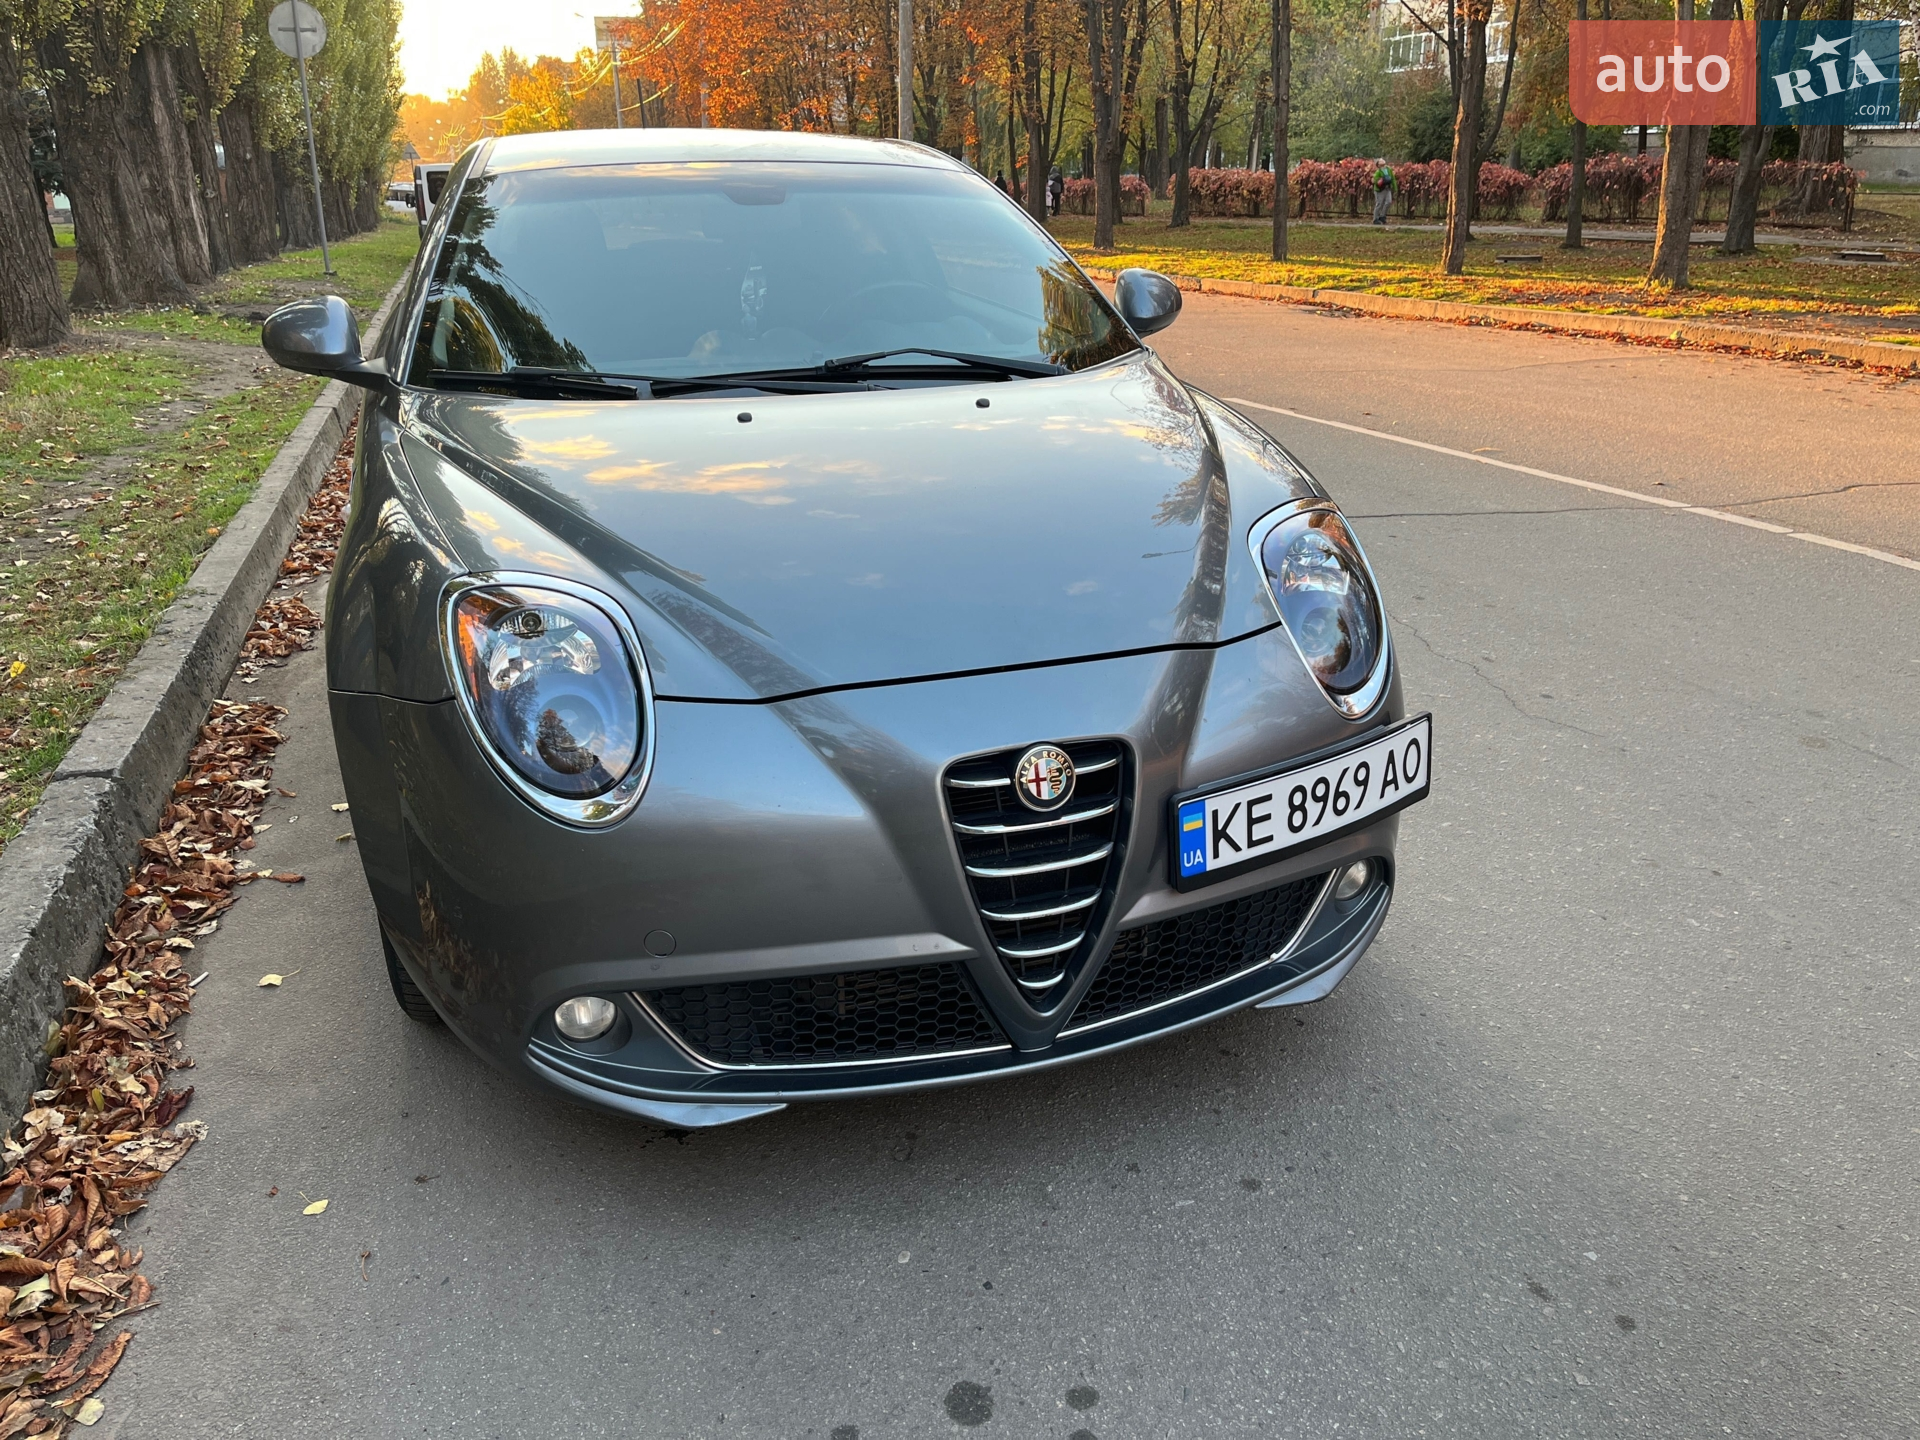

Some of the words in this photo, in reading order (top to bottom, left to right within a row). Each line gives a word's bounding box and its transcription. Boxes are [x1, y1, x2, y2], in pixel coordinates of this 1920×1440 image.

[1020, 755, 1038, 784] ALFA
[1042, 750, 1072, 777] ROMEO
[1211, 794, 1274, 860] KE
[1287, 761, 1371, 834] 8969
[1379, 737, 1421, 800] AO
[1183, 849, 1204, 868] UA
